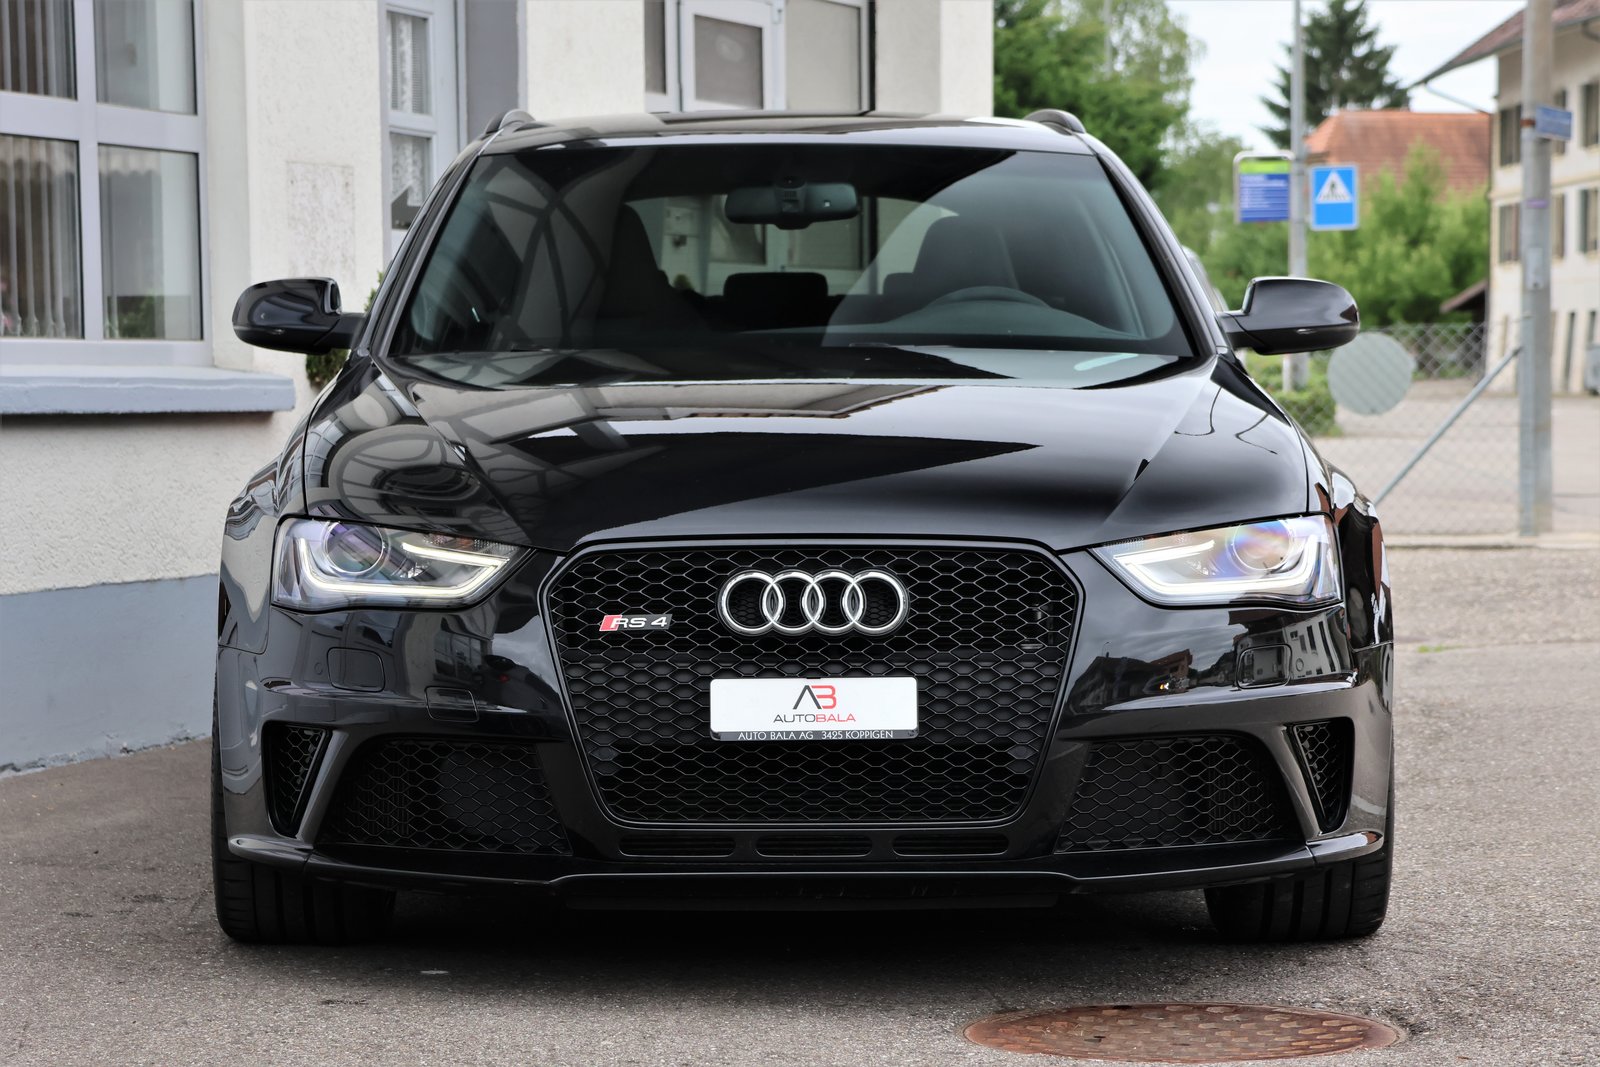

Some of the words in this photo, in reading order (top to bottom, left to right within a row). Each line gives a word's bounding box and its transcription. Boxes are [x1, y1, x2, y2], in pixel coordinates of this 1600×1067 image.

[609, 617, 648, 629] RS
[651, 616, 667, 628] 4
[772, 713, 857, 723] AUTOBALA
[738, 731, 767, 741] AUTO
[770, 731, 797, 741] BALA
[798, 731, 814, 740] AG
[821, 730, 843, 740] 3425
[845, 730, 894, 739] KOPPIGEN
